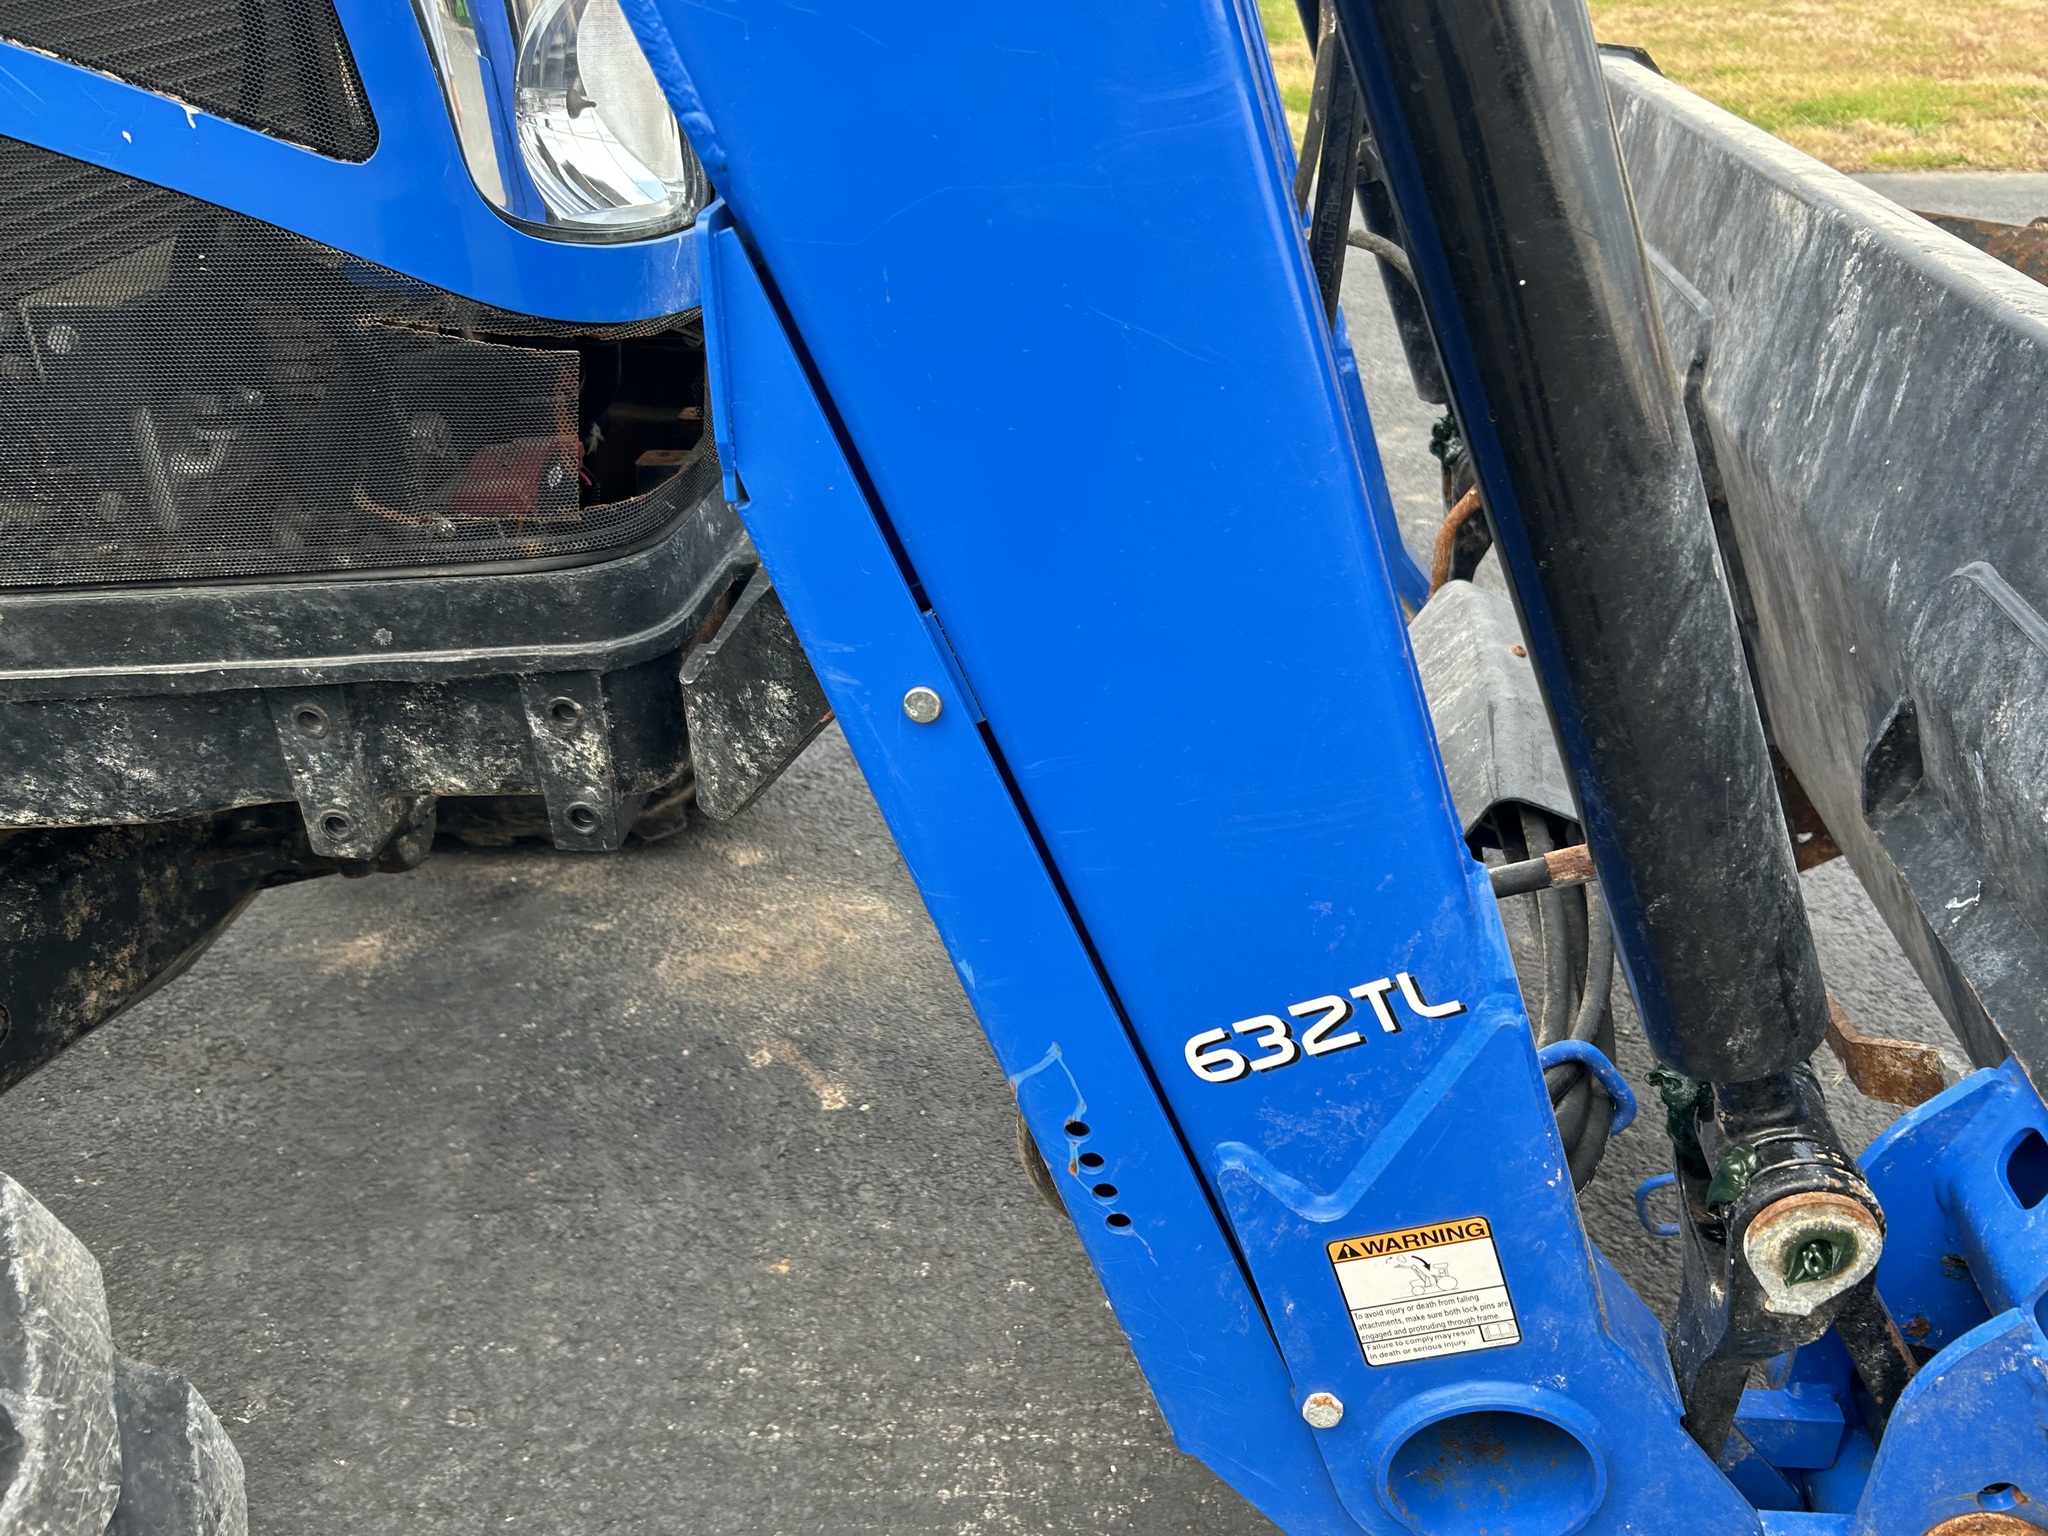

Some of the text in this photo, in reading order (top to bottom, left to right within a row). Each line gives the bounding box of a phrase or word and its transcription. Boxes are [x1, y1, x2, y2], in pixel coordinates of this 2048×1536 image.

[1184, 971, 1468, 1083] 632TL
[1360, 1222, 1486, 1255] WARNING
[1354, 1312, 1363, 1320] To
[1364, 1309, 1384, 1319] avoid
[1385, 1307, 1405, 1315] injury
[1416, 1301, 1437, 1310] death
[1438, 1298, 1456, 1307] from
[1457, 1294, 1480, 1303] falling
[1358, 1300, 1509, 1331] attachments, make sure both lock pins are
[1361, 1313, 1501, 1341] engaged and protruding through frame.
[1366, 1343, 1395, 1352] Failure
[1405, 1335, 1435, 1346] comply
[1434, 1332, 1453, 1341] may
[1453, 1328, 1475, 1337] result
[1379, 1349, 1401, 1358] death
[1402, 1347, 1412, 1355] or
[1412, 1342, 1443, 1353] serious
[1443, 1339, 1470, 1349] injury.
